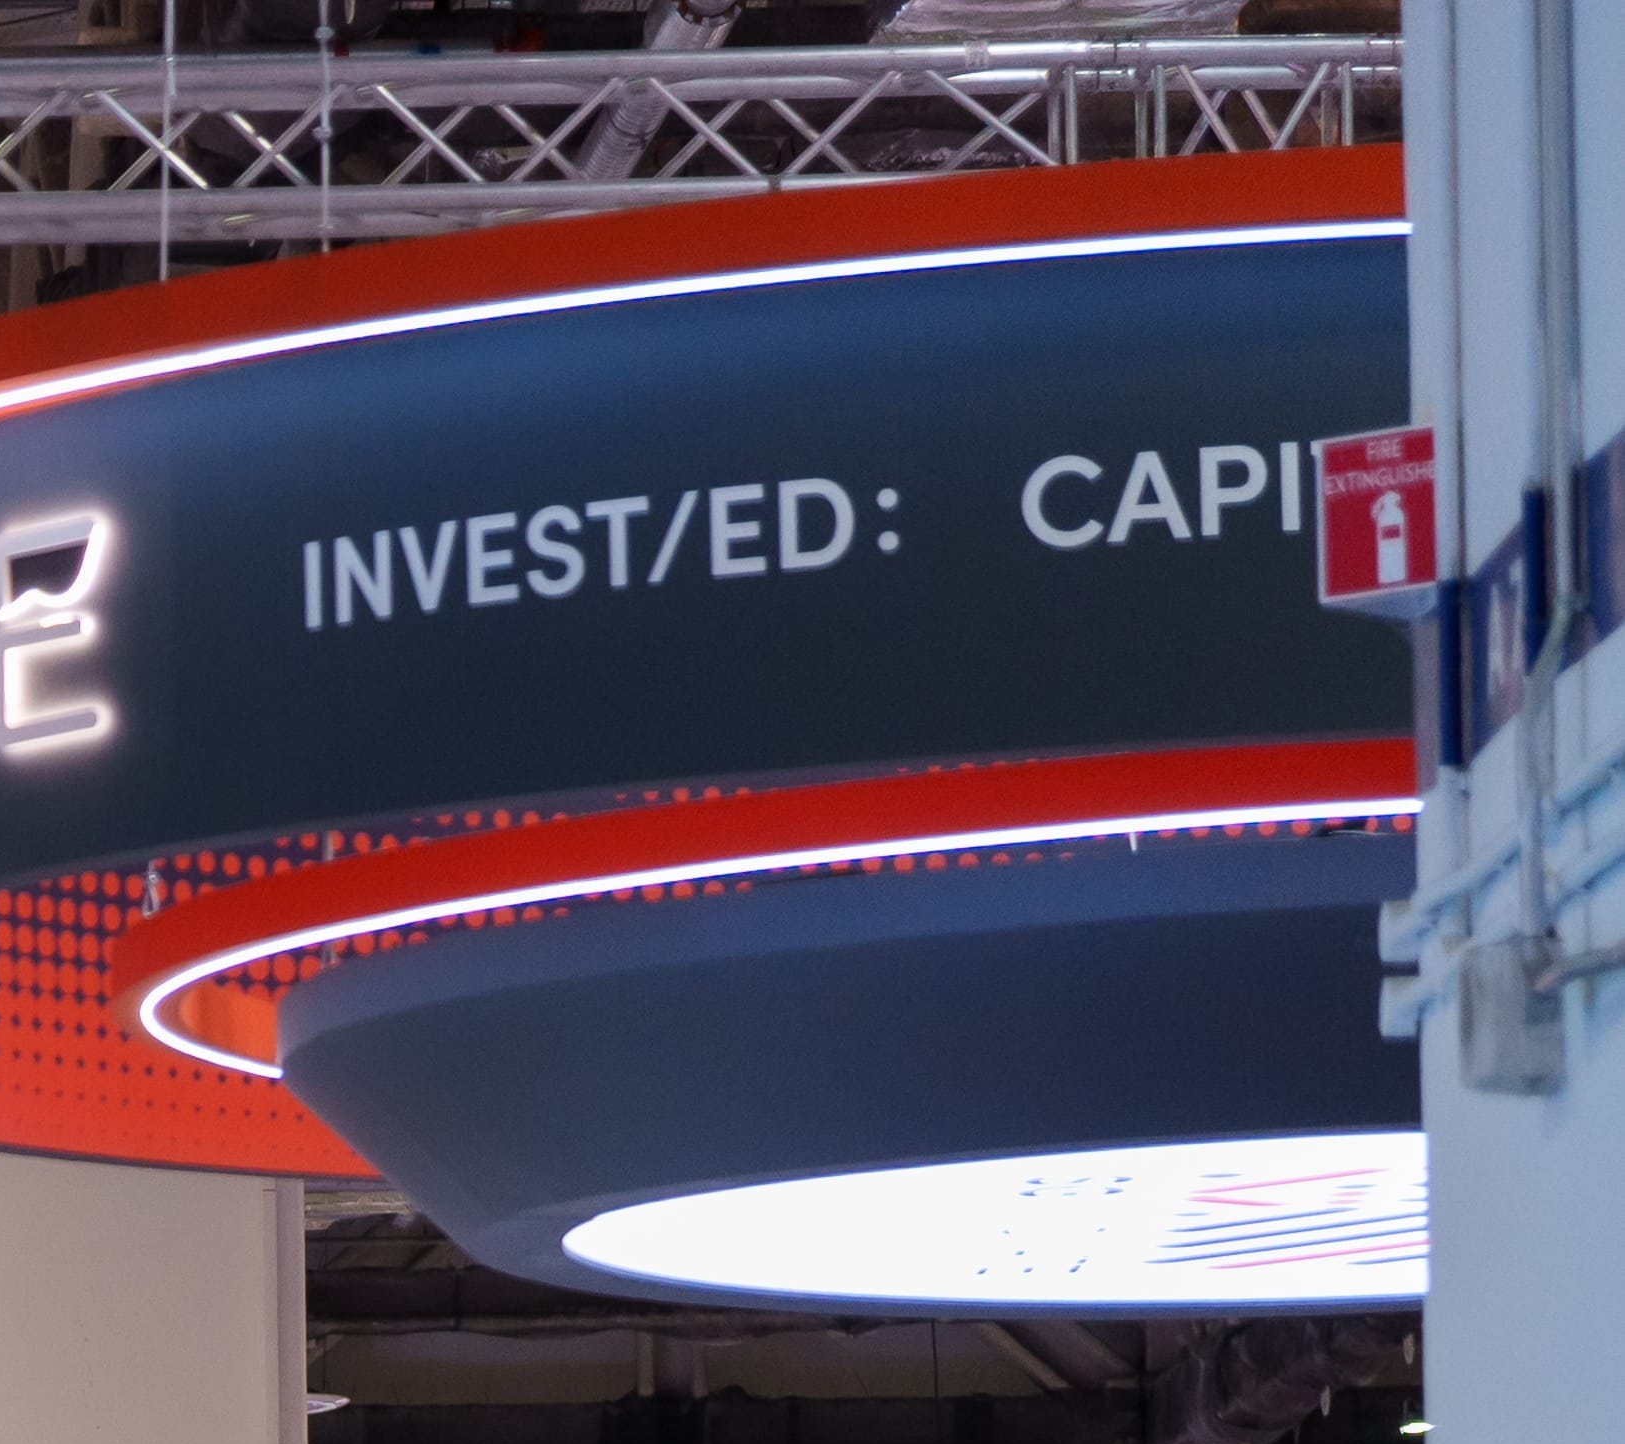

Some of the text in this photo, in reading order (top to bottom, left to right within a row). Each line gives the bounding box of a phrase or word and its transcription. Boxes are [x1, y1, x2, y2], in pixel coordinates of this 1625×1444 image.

[1366, 437, 1402, 462] FIRE
[1323, 460, 1436, 497] EXTINGUISHE
[302, 476, 901, 629] INVEST/ED:
